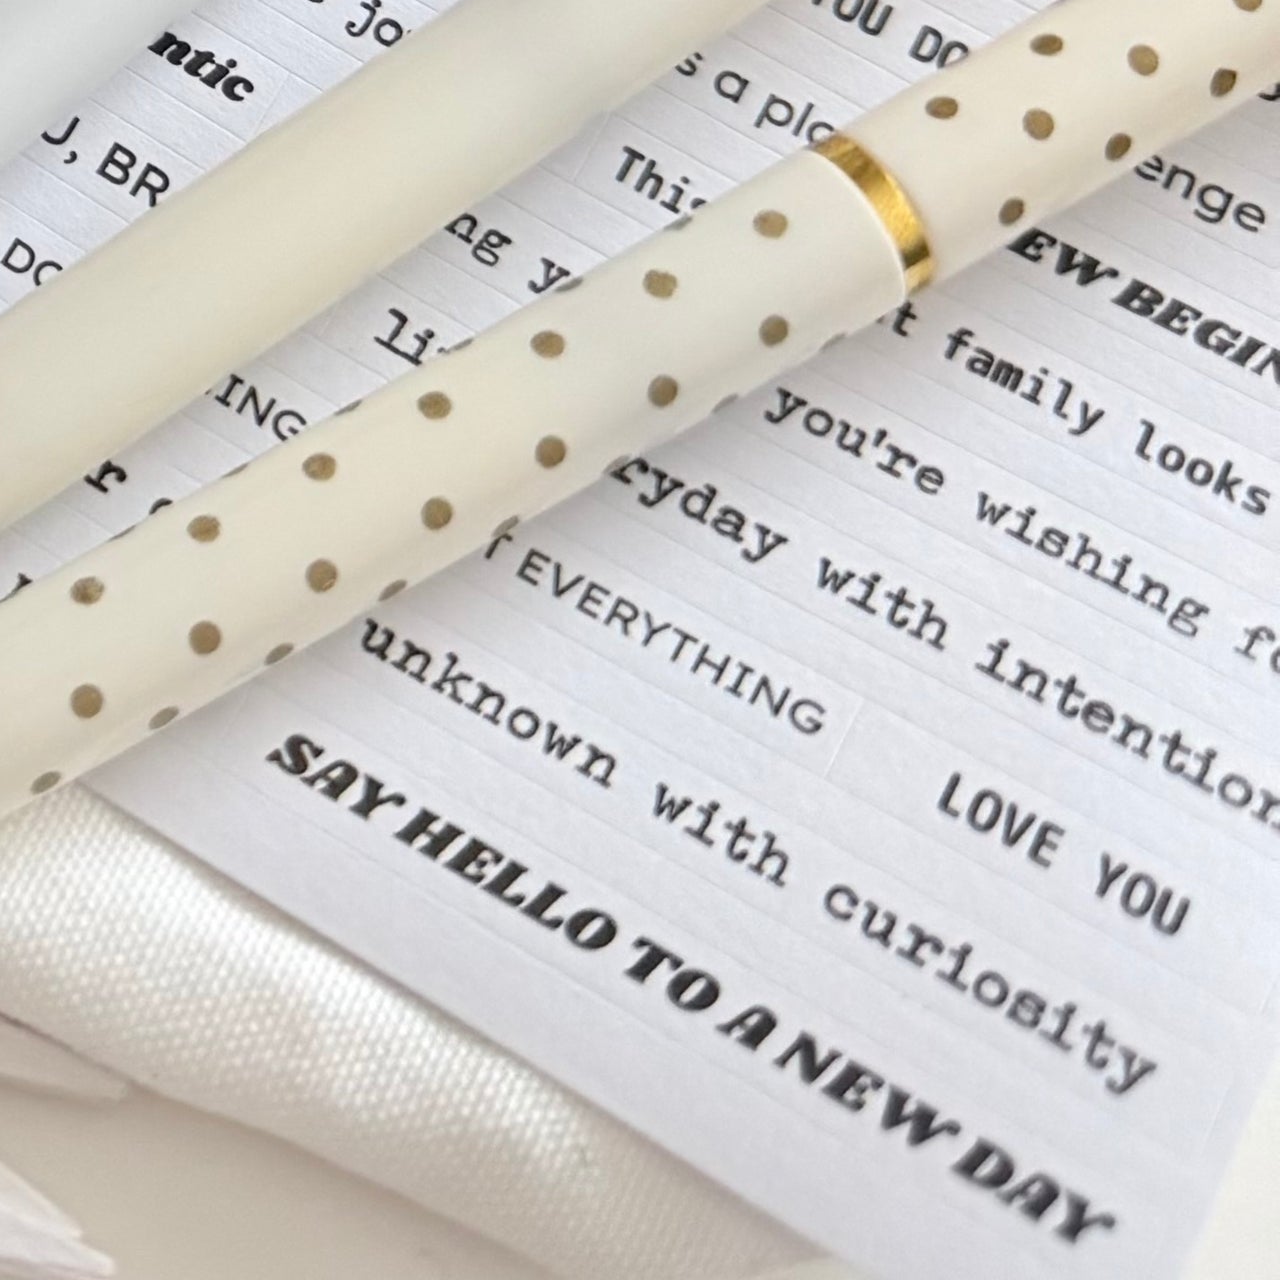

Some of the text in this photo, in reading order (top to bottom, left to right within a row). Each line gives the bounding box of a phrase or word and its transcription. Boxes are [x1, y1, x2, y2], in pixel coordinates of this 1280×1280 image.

[713, 68, 751, 104] a
[763, 386, 947, 496] you're
[976, 490, 1211, 639] wishing
[942, 327, 1107, 437] family
[1134, 417, 1273, 517] looks
[514, 547, 828, 740] EVERYTHING
[815, 555, 949, 653] with
[357, 614, 620, 790] unknown
[651, 779, 792, 890] with
[820, 881, 1158, 1100] curiosity
[937, 771, 1194, 939] LOVE YOU
[265, 729, 1119, 1245] SAY HELLO TO A NEW DAY
